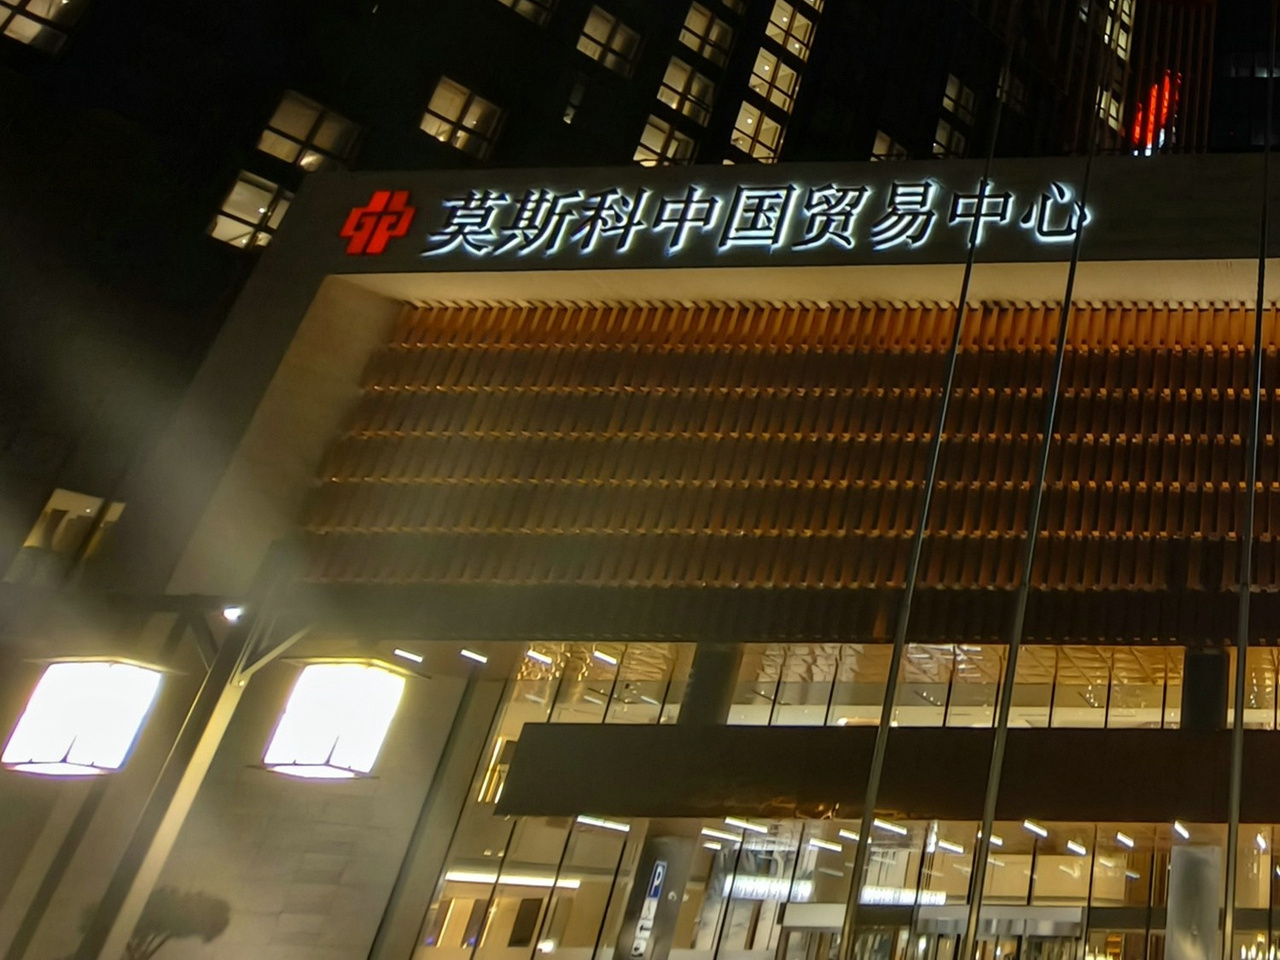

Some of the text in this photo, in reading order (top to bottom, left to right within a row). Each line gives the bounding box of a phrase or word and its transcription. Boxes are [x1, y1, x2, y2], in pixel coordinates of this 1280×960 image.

[421, 180, 1093, 256] 莫斯科中国贸易中心
[650, 866, 663, 897] P
